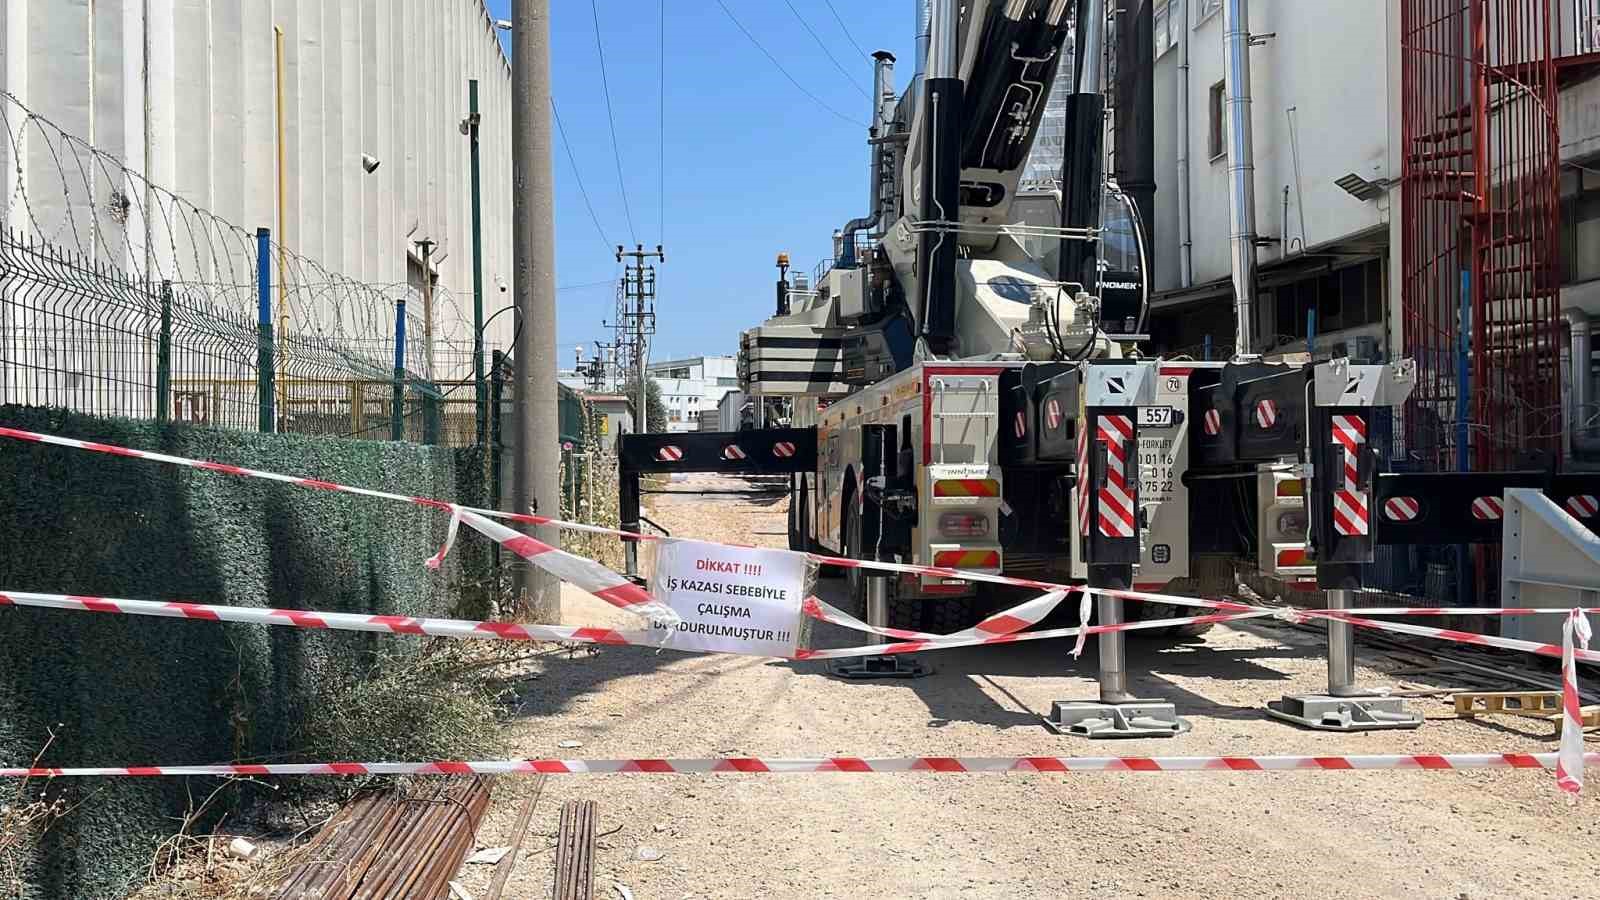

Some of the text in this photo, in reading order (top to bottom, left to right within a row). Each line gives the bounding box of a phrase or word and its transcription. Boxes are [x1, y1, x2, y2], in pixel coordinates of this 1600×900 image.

[1095, 281, 1137, 290] NNOMEK
[1147, 408, 1170, 423] 557
[1137, 439, 1173, 449] -FORKLIFT
[1161, 454, 1173, 465] 16
[1161, 467, 1173, 479] 16
[1161, 481, 1174, 492] 22
[696, 558, 762, 577] DİKKAT !!!!
[667, 576, 787, 600] İŞ KAZASI SEBEBİYLE
[697, 602, 752, 620] ÇALIŞMA
[654, 620, 791, 642] DDURULMUŞTUR !!!
